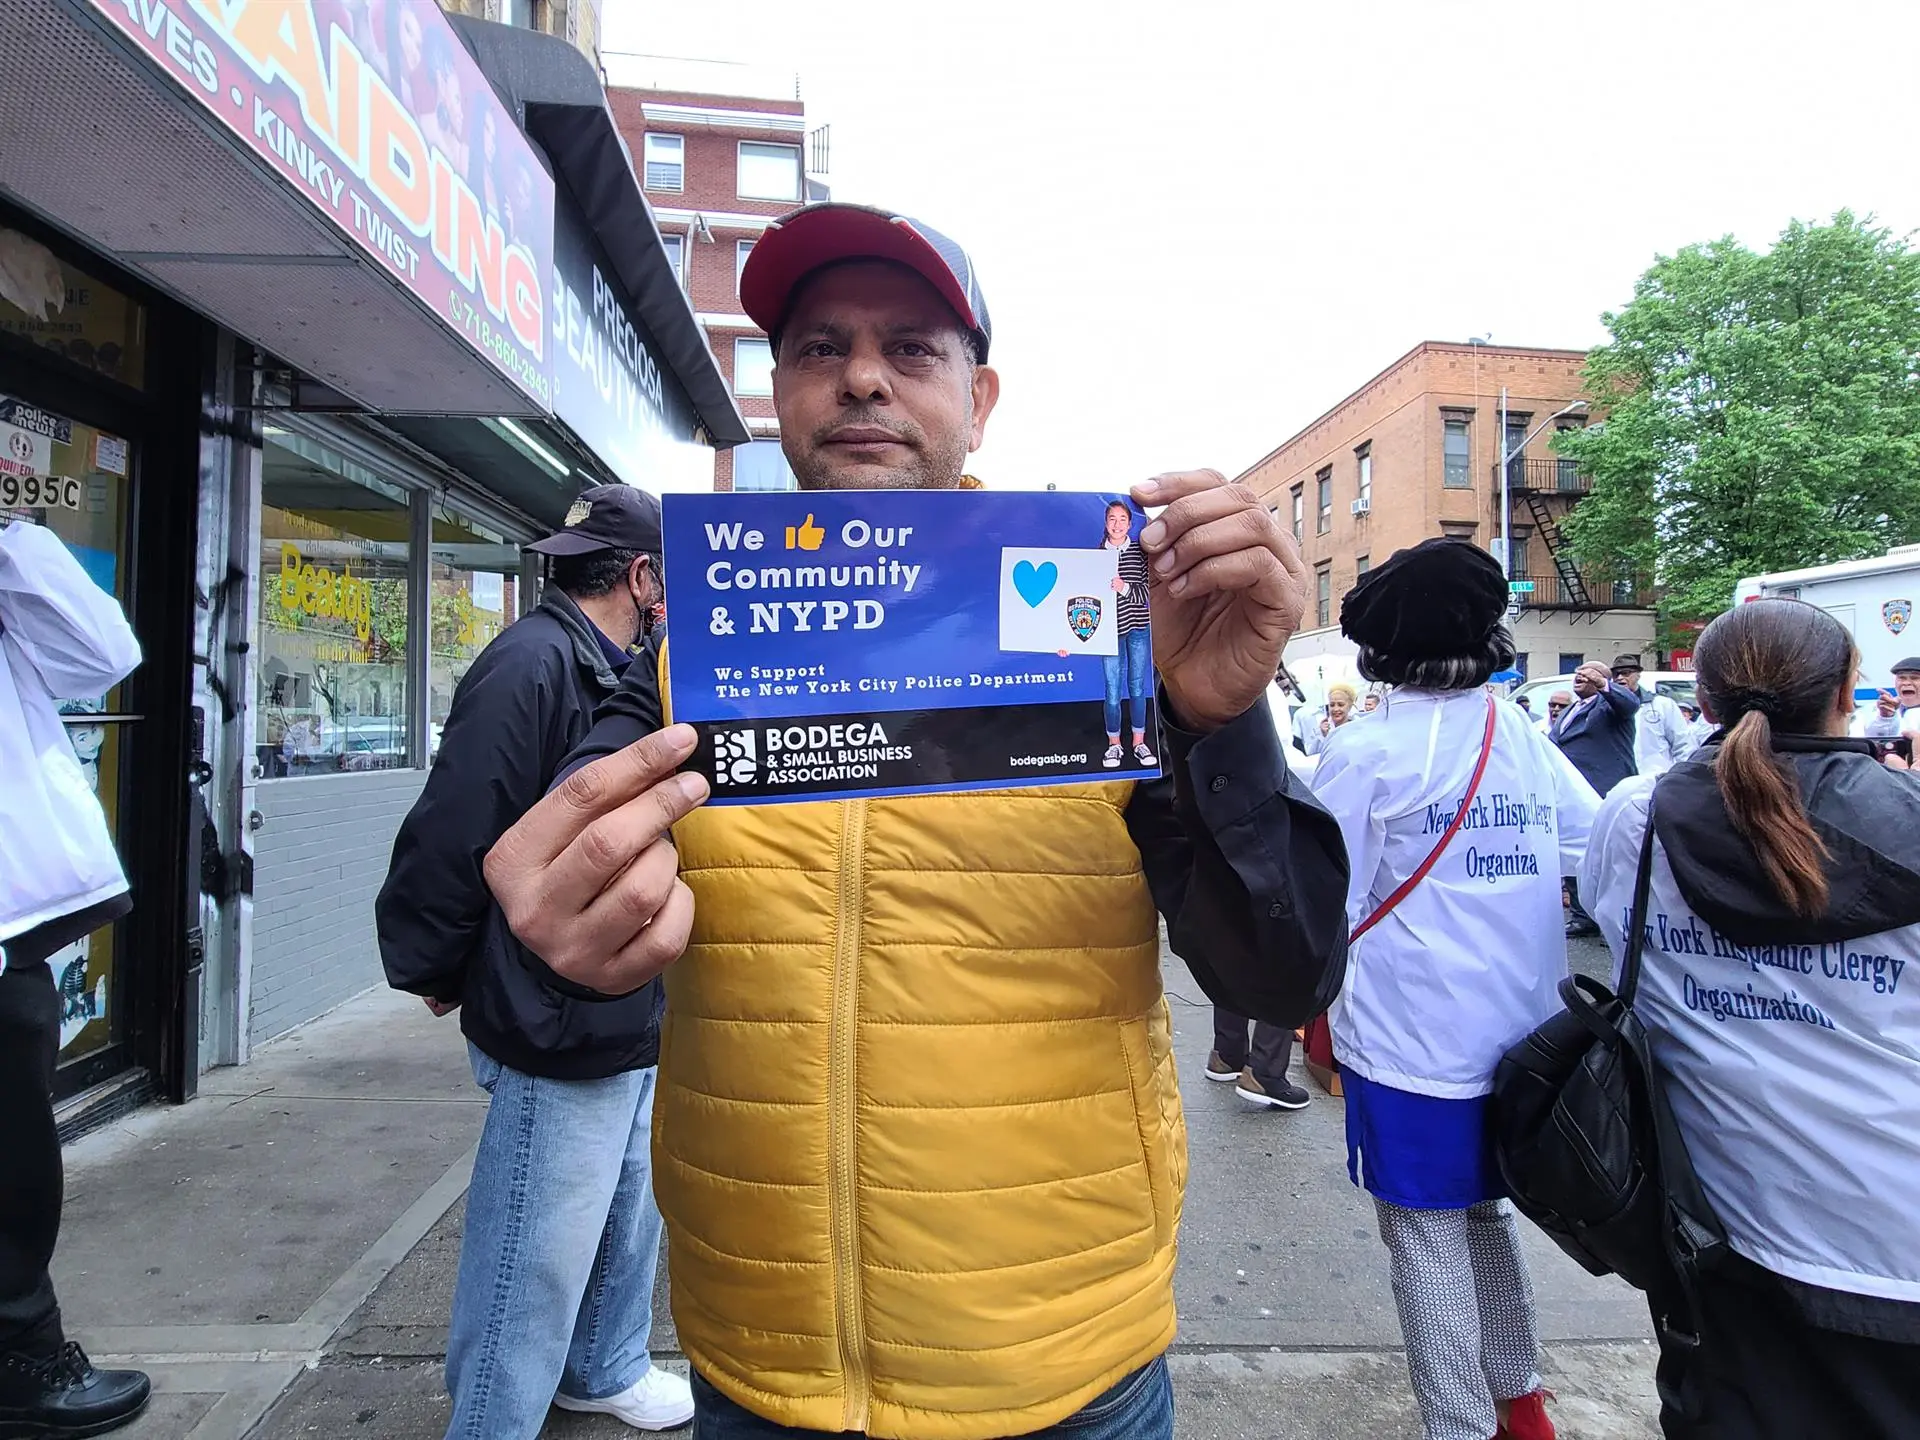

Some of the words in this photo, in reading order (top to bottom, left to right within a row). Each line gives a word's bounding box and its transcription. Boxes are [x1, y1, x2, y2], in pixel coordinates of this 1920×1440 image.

[254, 95, 345, 209] KINKY
[350, 189, 419, 280] TWIST
[464, 302, 549, 401] 718-860-2943
[553, 264, 637, 431] BEAUTY
[593, 264, 664, 416] PRECIOSA
[15, 405, 57, 427] police
[16, 415, 55, 438] news
[704, 522, 765, 551] We
[841, 519, 913, 548] Our
[706, 556, 921, 592] Community
[709, 606, 736, 636] &
[749, 599, 885, 634] NYPD
[714, 667, 743, 680] We
[751, 664, 825, 681] Support
[716, 685, 751, 698] The
[759, 683, 799, 697] New
[806, 680, 851, 694] York
[858, 678, 898, 693] City
[905, 675, 963, 689] Police
[969, 670, 1074, 688] Department
[766, 722, 888, 752] BODEGA
[766, 754, 778, 768] &
[782, 750, 833, 767] SMALL
[838, 745, 913, 762] BUSINESS
[1009, 753, 1087, 767] bodegasbg.org
[767, 764, 878, 784] ASSOCIATION
[1657, 913, 1708, 955] York
[1820, 941, 1906, 994] Clergy
[1683, 973, 1836, 1030] Organization
